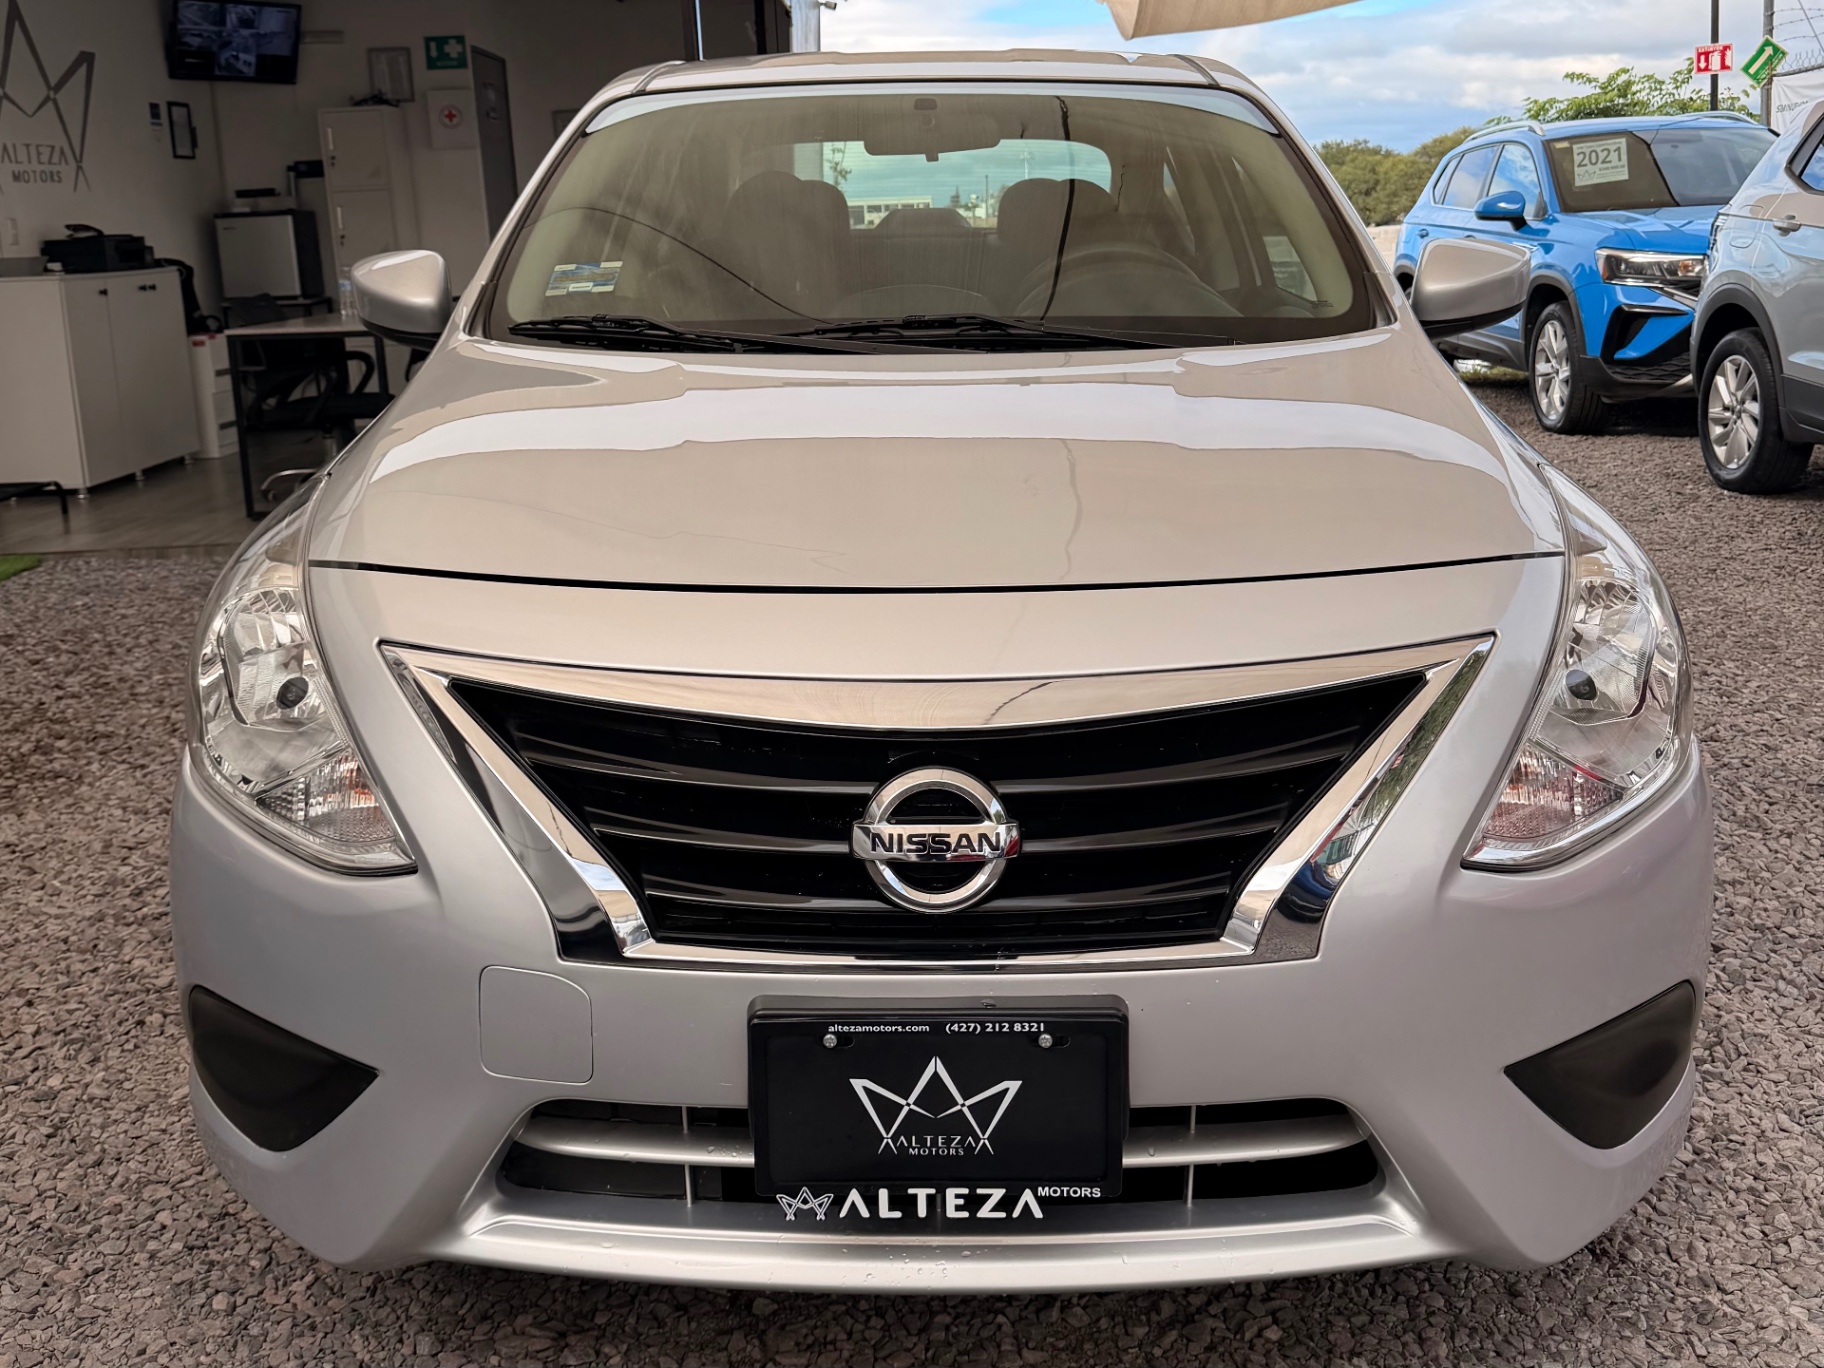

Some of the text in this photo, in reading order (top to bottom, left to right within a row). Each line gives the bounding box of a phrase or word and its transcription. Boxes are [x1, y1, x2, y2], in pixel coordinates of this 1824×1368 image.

[1, 142, 69, 166] ALTEZA
[1576, 146, 1622, 168] 2021
[12, 169, 62, 184] MOTORS
[869, 832, 1001, 854] NISSAN
[828, 1022, 1045, 1034] altezamotors.com (427) 212 8321
[896, 1135, 976, 1148] ALTEZA
[908, 1147, 964, 1156] MOTORS
[839, 1186, 1101, 1219] ALTEZA MOTORS
